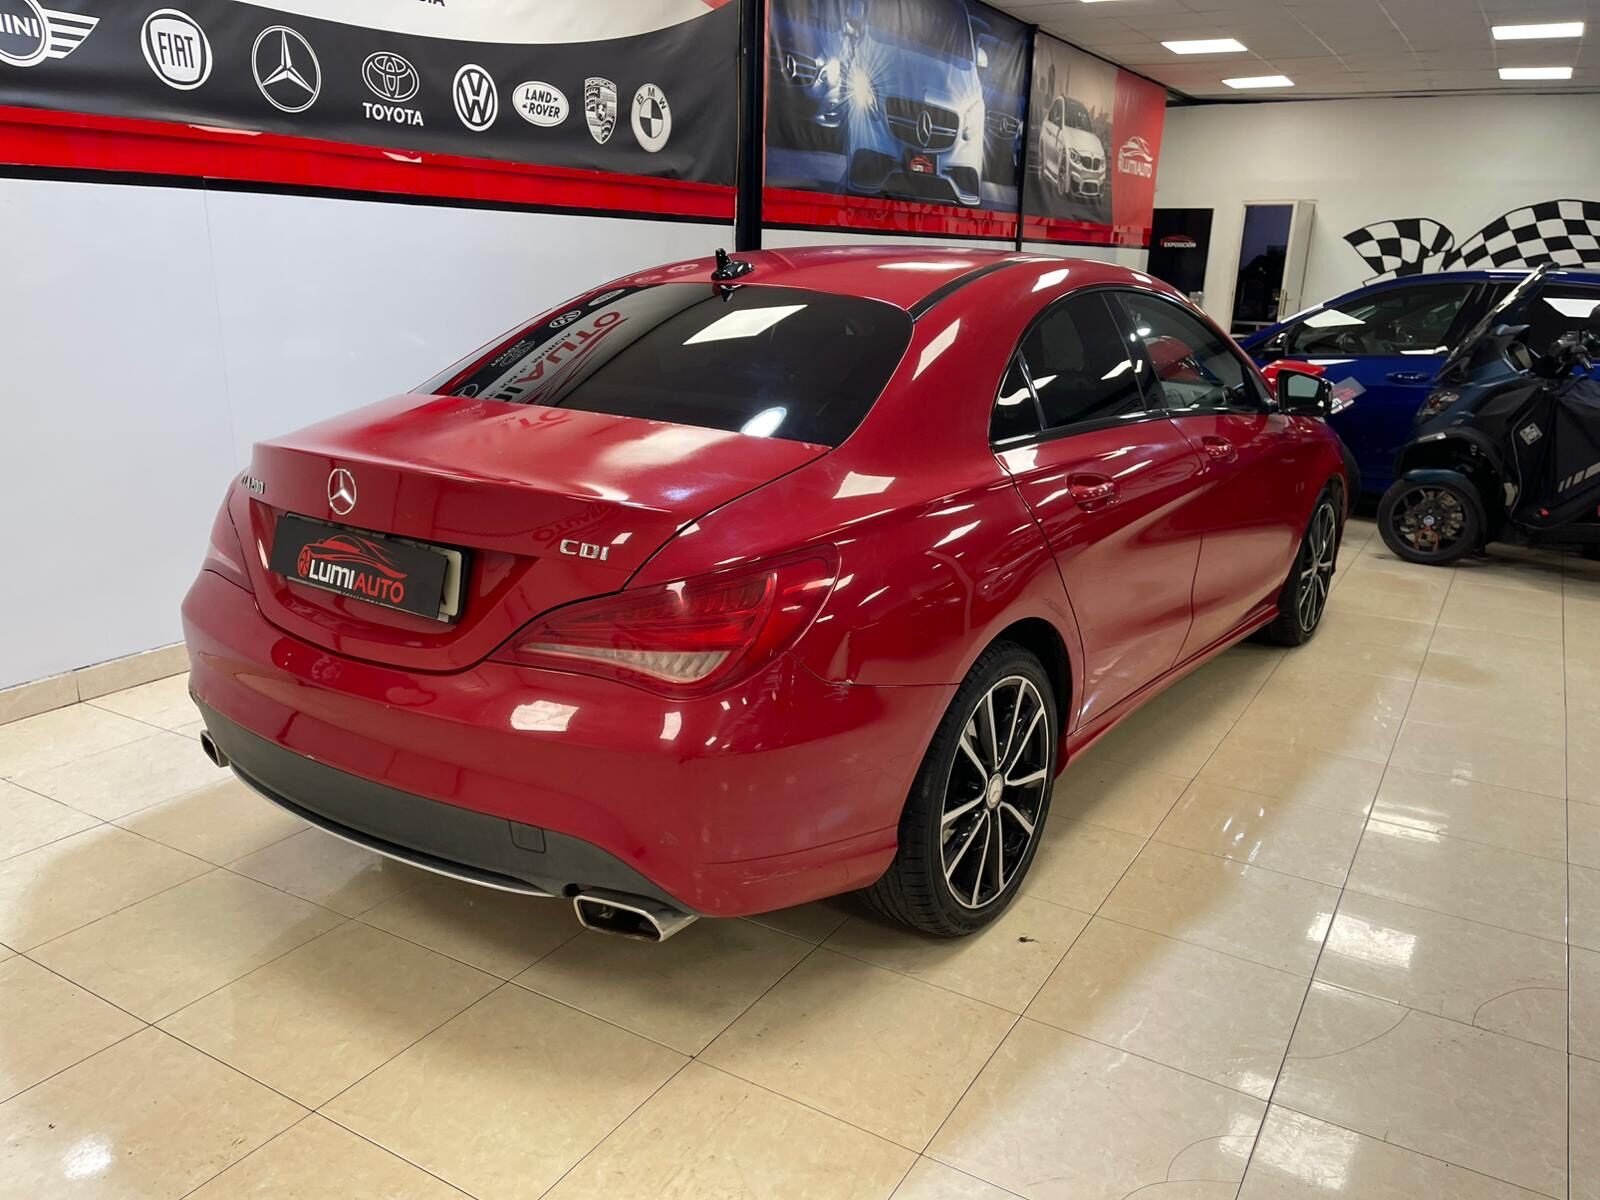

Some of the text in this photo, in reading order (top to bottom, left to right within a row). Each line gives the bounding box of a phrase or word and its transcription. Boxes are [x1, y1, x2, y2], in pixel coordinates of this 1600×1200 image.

[0, 13, 40, 38] INI
[157, 31, 195, 69] FIAT
[524, 87, 552, 103] LAND
[636, 87, 667, 110] BMW
[362, 102, 424, 127] TOYOTA
[528, 103, 561, 119] ROVER
[560, 538, 610, 561] CDI
[308, 558, 405, 604] LUMIAUTO
